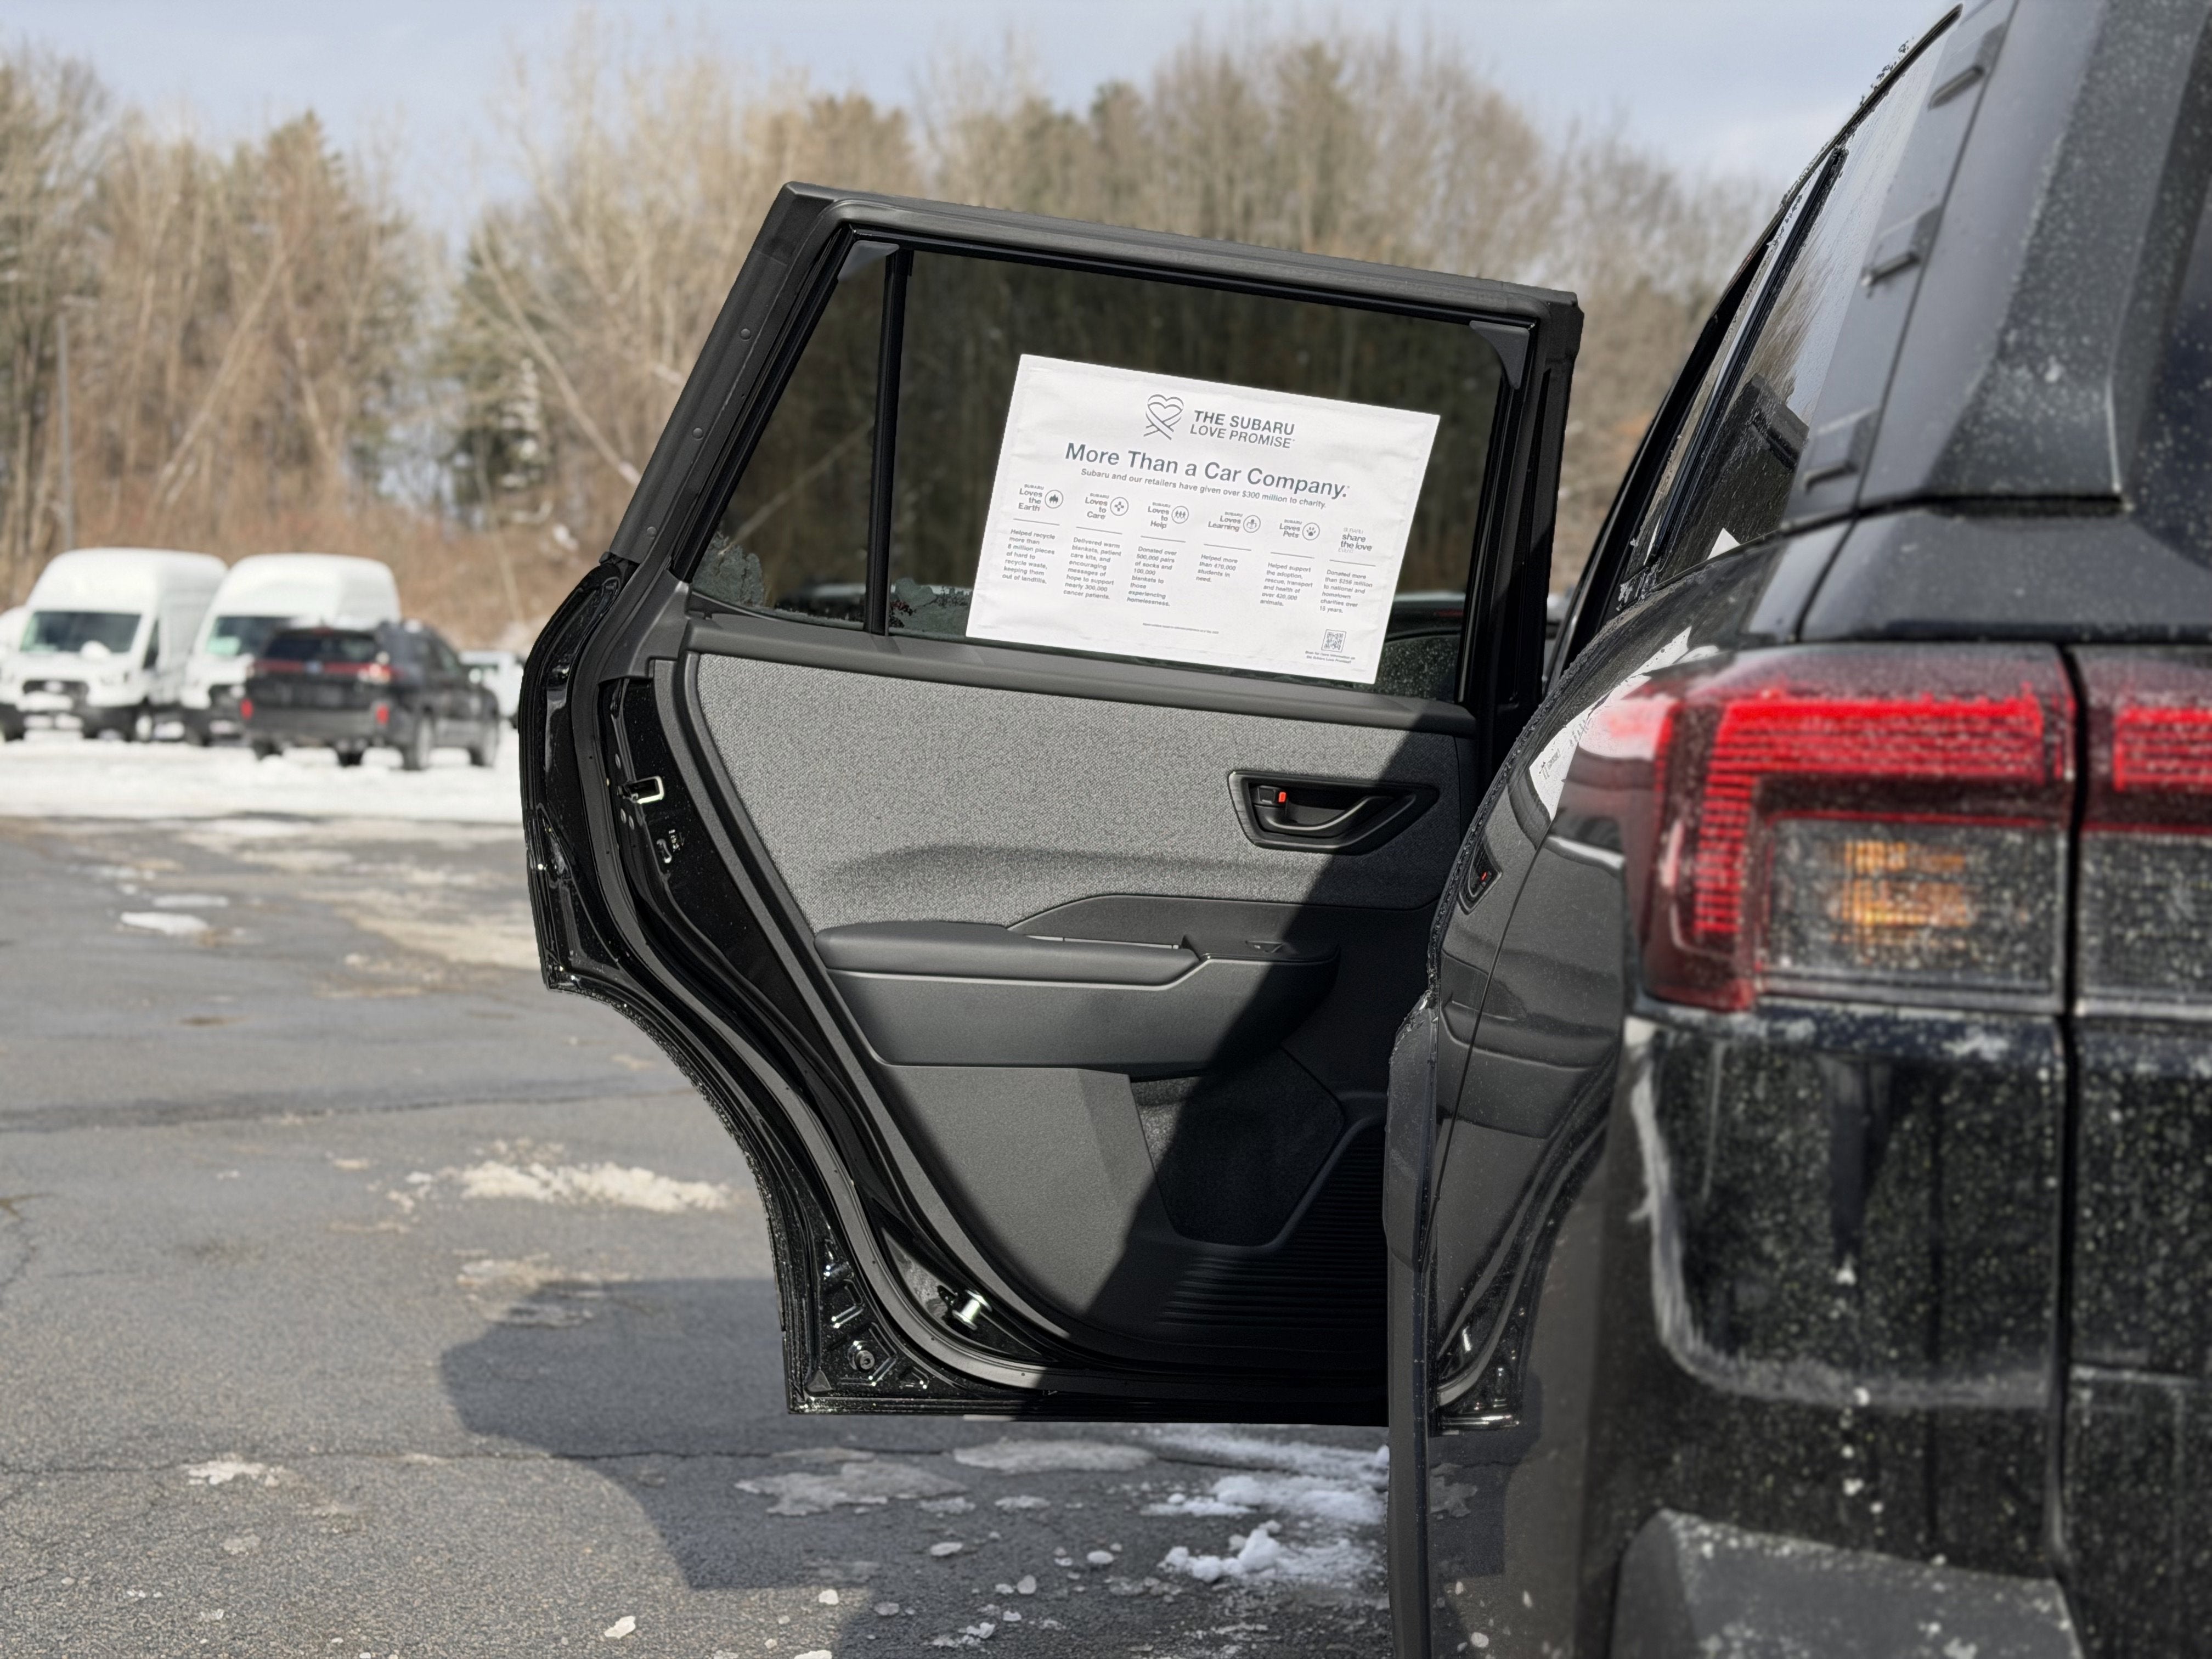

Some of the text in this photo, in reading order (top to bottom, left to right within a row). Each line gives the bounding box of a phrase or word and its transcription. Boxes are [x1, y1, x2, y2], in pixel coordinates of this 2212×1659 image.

[1194, 410, 1295, 435] THE SUBARU
[1190, 424, 1291, 449] LOVE PROMISE
[1065, 442, 1350, 500] More Than a Car Company.
[1019, 488, 1042, 498] Loves
[1081, 468, 1110, 478] Subaru
[1144, 478, 1177, 488] retailers
[1178, 482, 1198, 491] have
[1200, 485, 1221, 494] given
[1242, 490, 1260, 499] $300
[1262, 494, 1288, 503] million
[1299, 498, 1326, 510] charity.
[1085, 497, 1108, 506] Loves
[1018, 503, 1040, 511] Earth
[1148, 506, 1169, 515] Loves
[1087, 511, 1106, 520] Care
[1220, 515, 1241, 524] Loves
[1150, 520, 1167, 529] Help
[1207, 521, 1240, 533] Learning
[1279, 523, 1300, 532] Loves
[1283, 530, 1300, 538] Pets
[1342, 533, 1366, 543] share
[1073, 537, 1102, 546] Delivered
[1341, 540, 1372, 551] the love
[1138, 546, 1163, 554] Donated
[1069, 560, 1107, 570] encouraging
[1003, 566, 1028, 575] keeping
[1068, 568, 1098, 576] messages
[1327, 569, 1351, 578] Donated
[1128, 590, 1166, 600] experiencing
